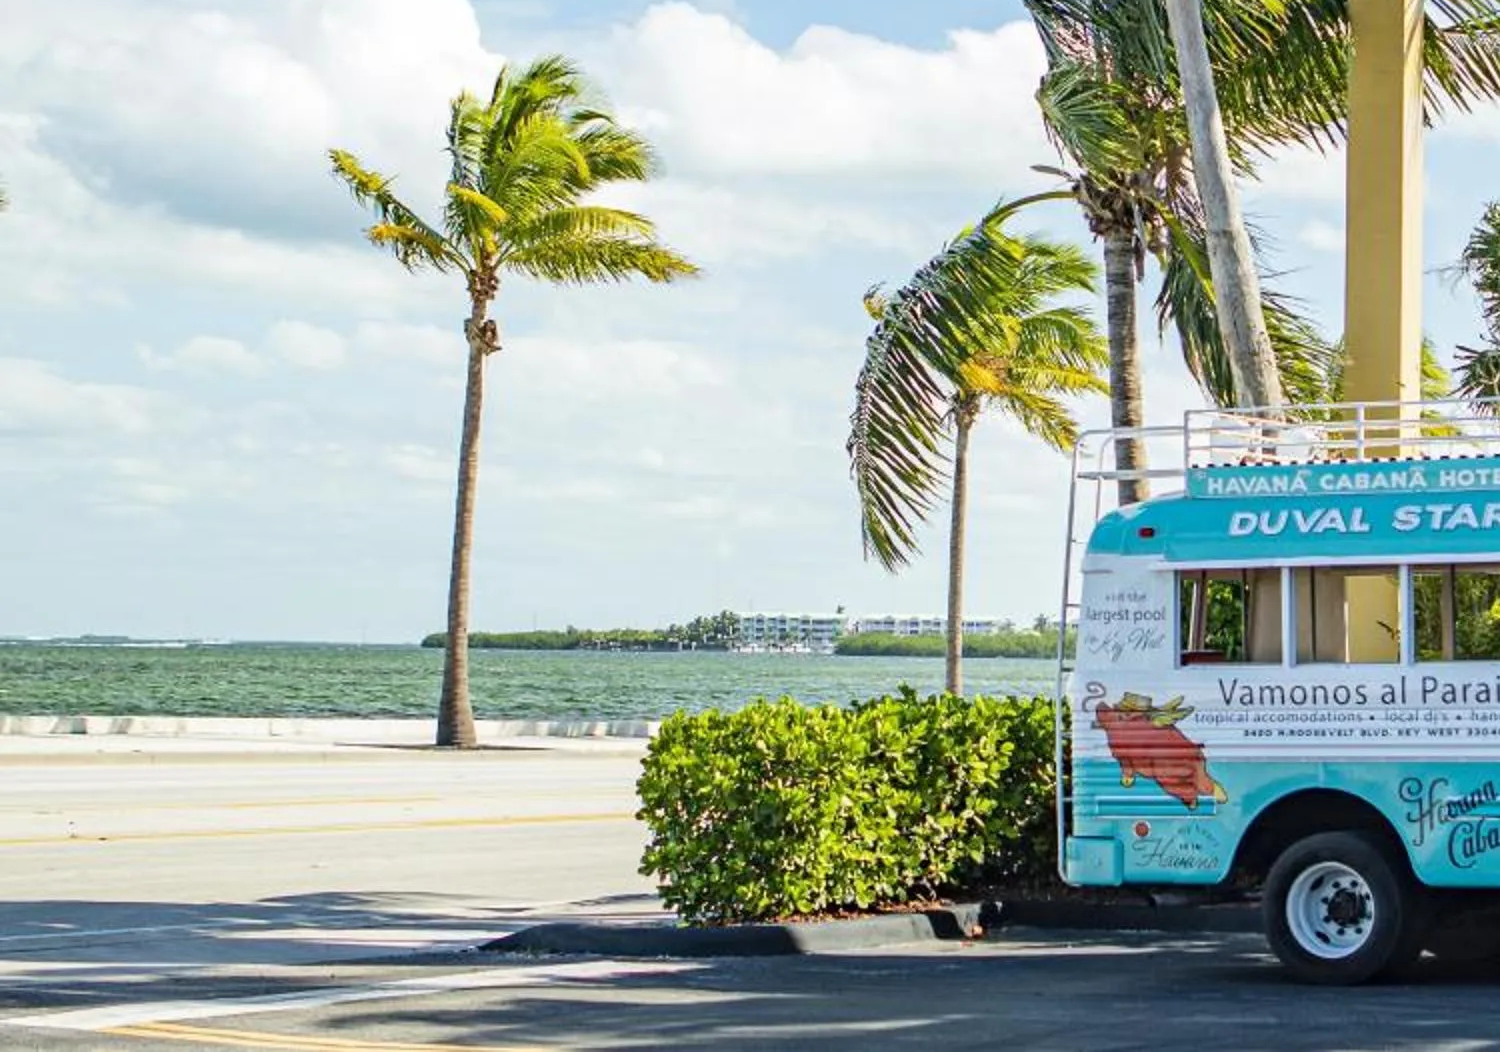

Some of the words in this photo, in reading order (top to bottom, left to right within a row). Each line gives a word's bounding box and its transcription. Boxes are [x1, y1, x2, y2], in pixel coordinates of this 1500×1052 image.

[1207, 473, 1305, 494] HAVANA
[1319, 469, 1427, 490] CABANA
[1228, 506, 1372, 536] DUVAL
[1086, 606, 1129, 625] largest
[1133, 606, 1166, 624] pool
[1218, 678, 1368, 706] Vamonos
[1381, 676, 1407, 705] al
[1194, 710, 1249, 725] tropical
[1253, 710, 1364, 723] accomodations
[1385, 709, 1418, 723] local
[1427, 727, 1460, 736] WEST
[1399, 777, 1500, 846] Havana
